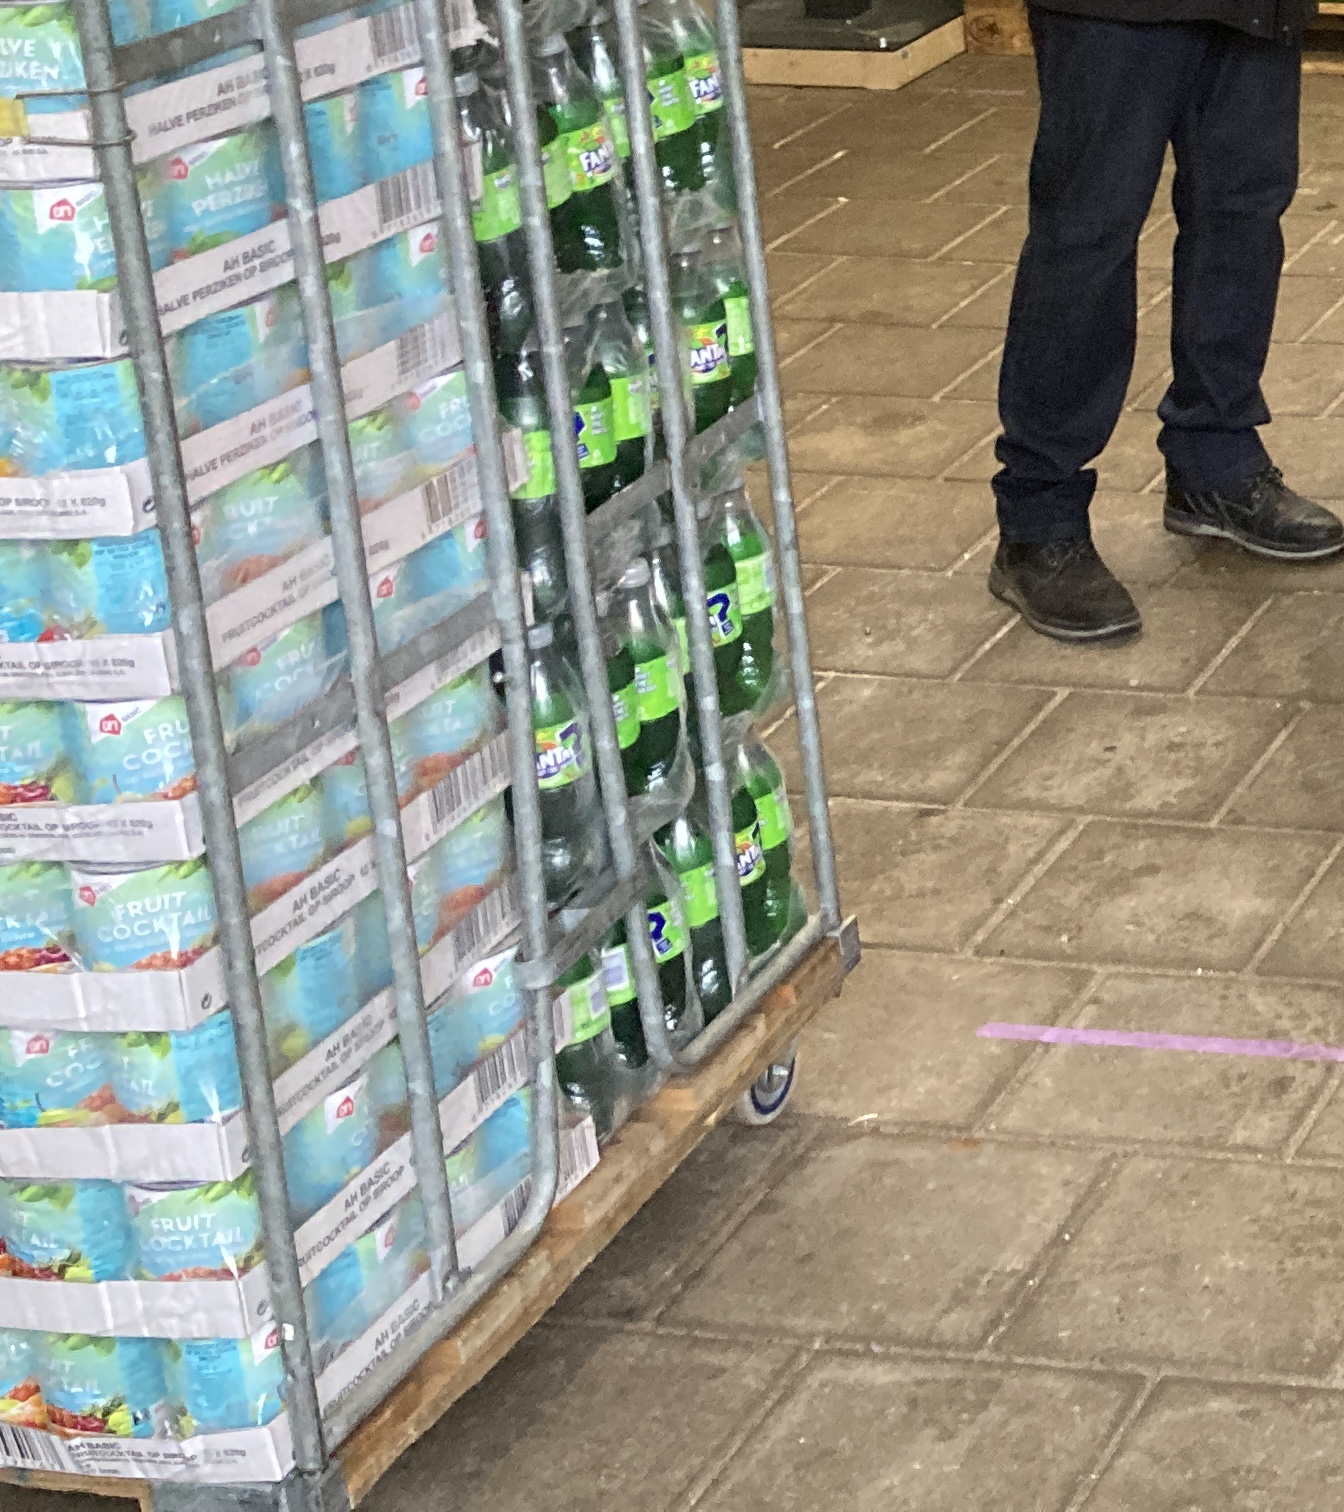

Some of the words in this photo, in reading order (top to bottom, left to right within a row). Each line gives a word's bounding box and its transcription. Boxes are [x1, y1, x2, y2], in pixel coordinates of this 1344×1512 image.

[223, 255, 240, 274] AH
[240, 239, 277, 268] BASIC
[143, 719, 190, 745] FRU
[113, 892, 187, 923] FRUIT
[150, 1213, 218, 1235] FRUIT
